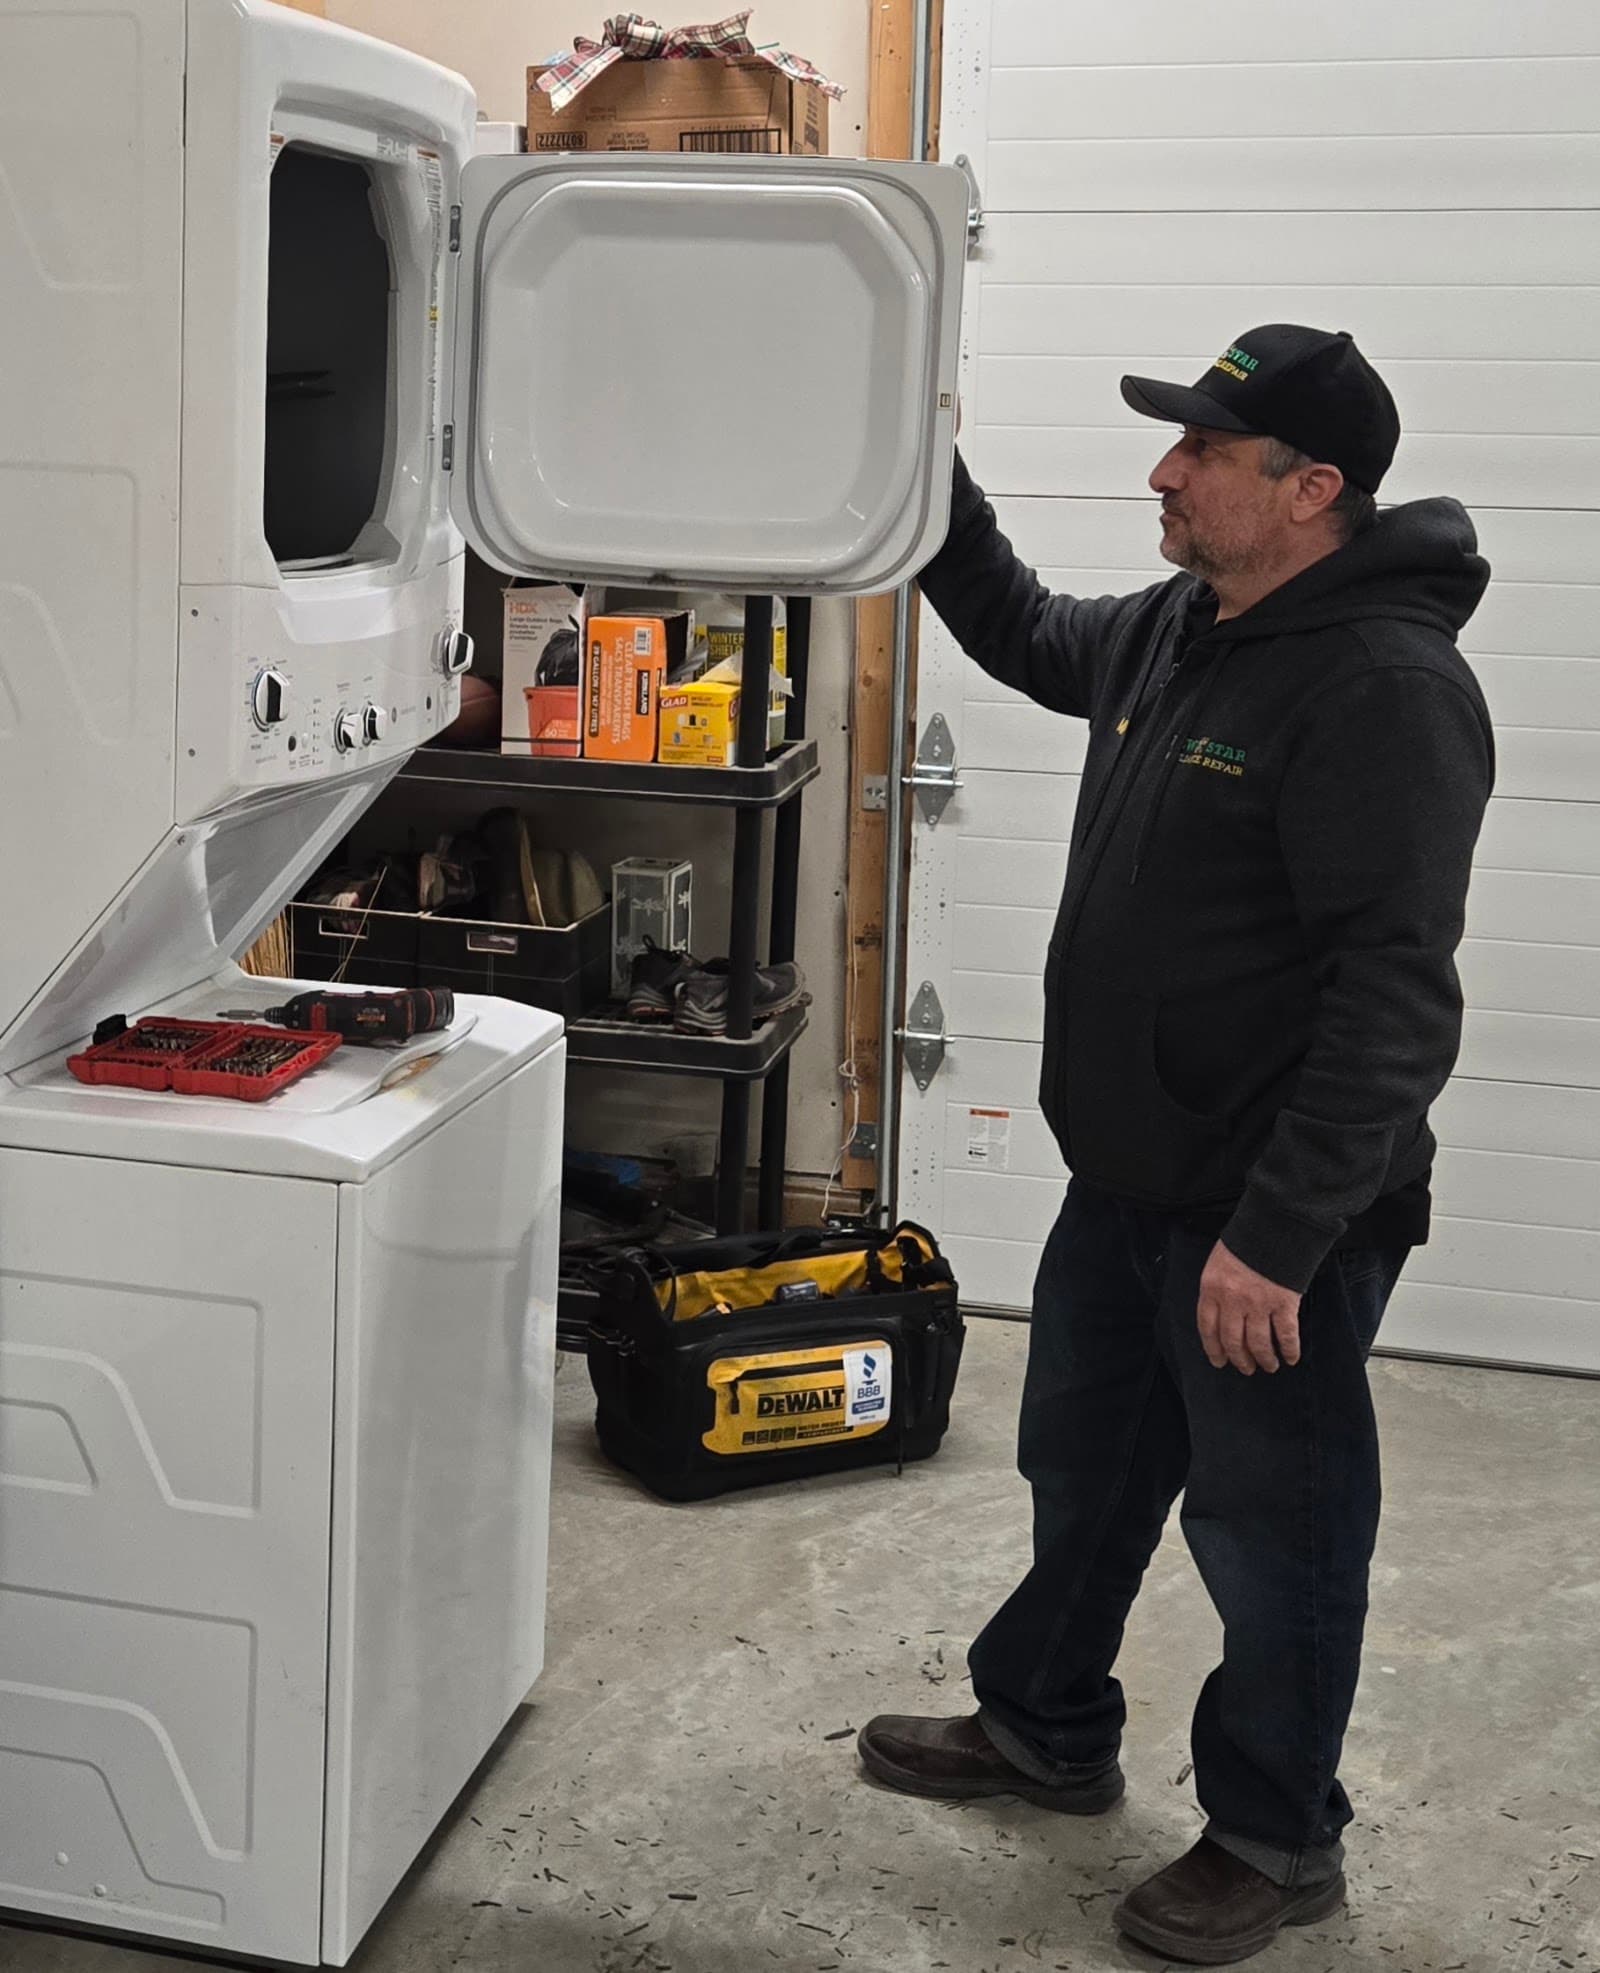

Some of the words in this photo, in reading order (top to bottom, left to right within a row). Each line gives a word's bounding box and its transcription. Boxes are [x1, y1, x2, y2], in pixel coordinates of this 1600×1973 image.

[509, 601, 538, 614] HDX
[614, 637, 623, 663] SACS
[624, 641, 633, 674] CLEAR
[592, 656, 600, 688] GALLON
[611, 666, 623, 744] TRANSPARENTS
[624, 677, 632, 710] TRASH
[641, 671, 649, 714] KIRKLAND
[661, 697, 687, 707] GLAD
[590, 708, 598, 733] LITRES
[622, 712, 631, 740] BAGS
[1202, 756, 1244, 776] REPAIR
[857, 1385, 881, 1399] BBB
